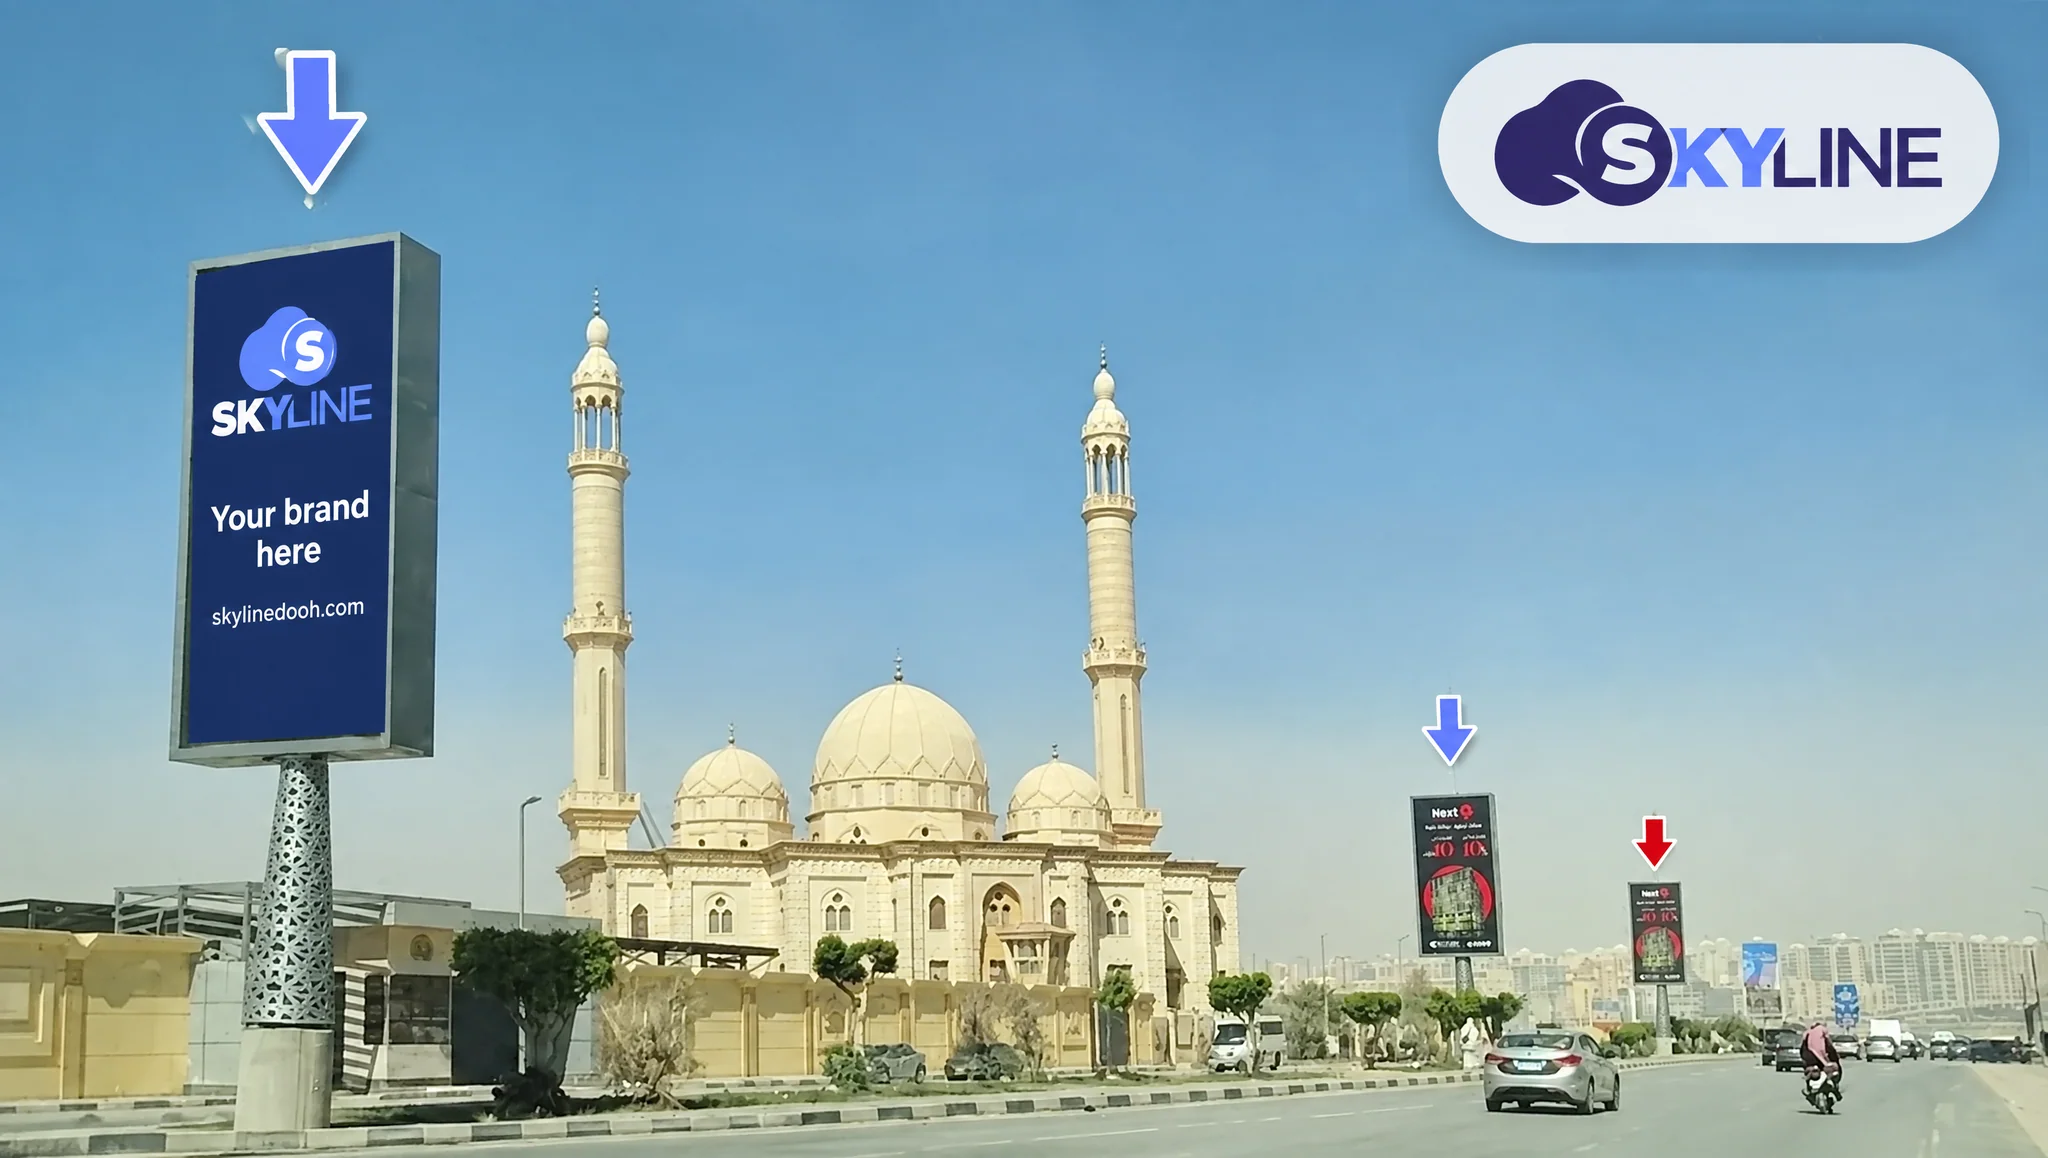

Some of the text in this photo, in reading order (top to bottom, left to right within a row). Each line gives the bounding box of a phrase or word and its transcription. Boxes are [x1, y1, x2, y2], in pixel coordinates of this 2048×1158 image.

[295, 330, 325, 372] S
[211, 383, 372, 437] SKYLINE
[211, 489, 369, 533] Your brand
[257, 539, 321, 567] here
[212, 599, 364, 629] skylinedooh.com
[1431, 807, 1459, 818] Next
[1641, 889, 1659, 898] Next
